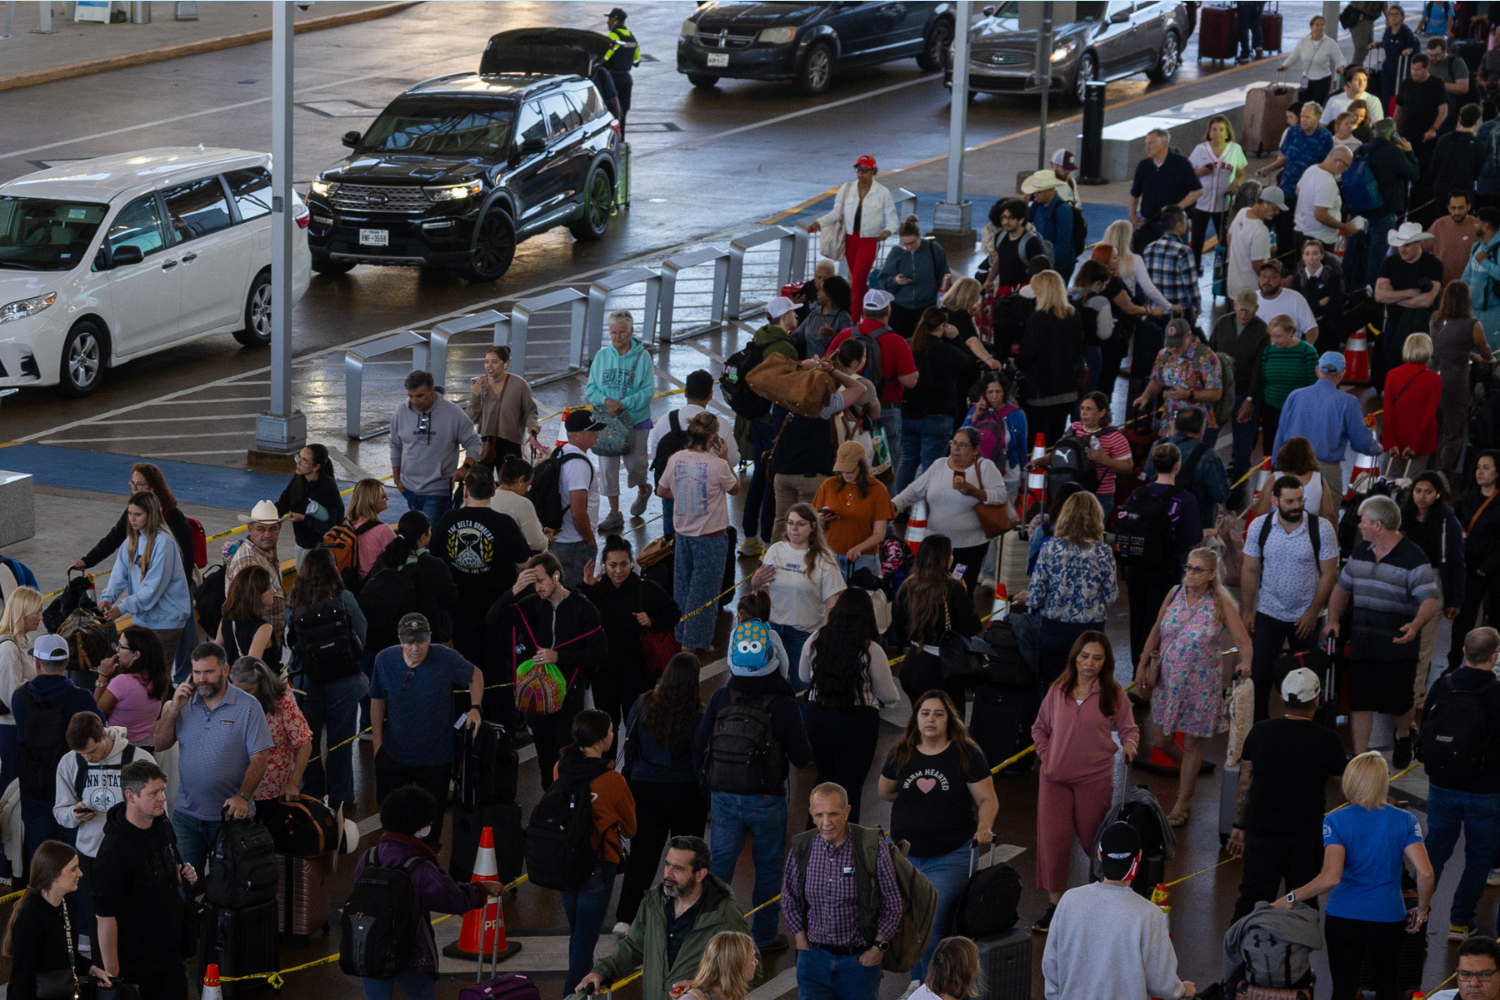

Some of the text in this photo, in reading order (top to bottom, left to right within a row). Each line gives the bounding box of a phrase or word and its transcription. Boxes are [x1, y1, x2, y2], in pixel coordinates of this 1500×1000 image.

[447, 526, 458, 536] THE
[456, 519, 473, 529] DELTA
[902, 768, 950, 791] WARM HEARTED
